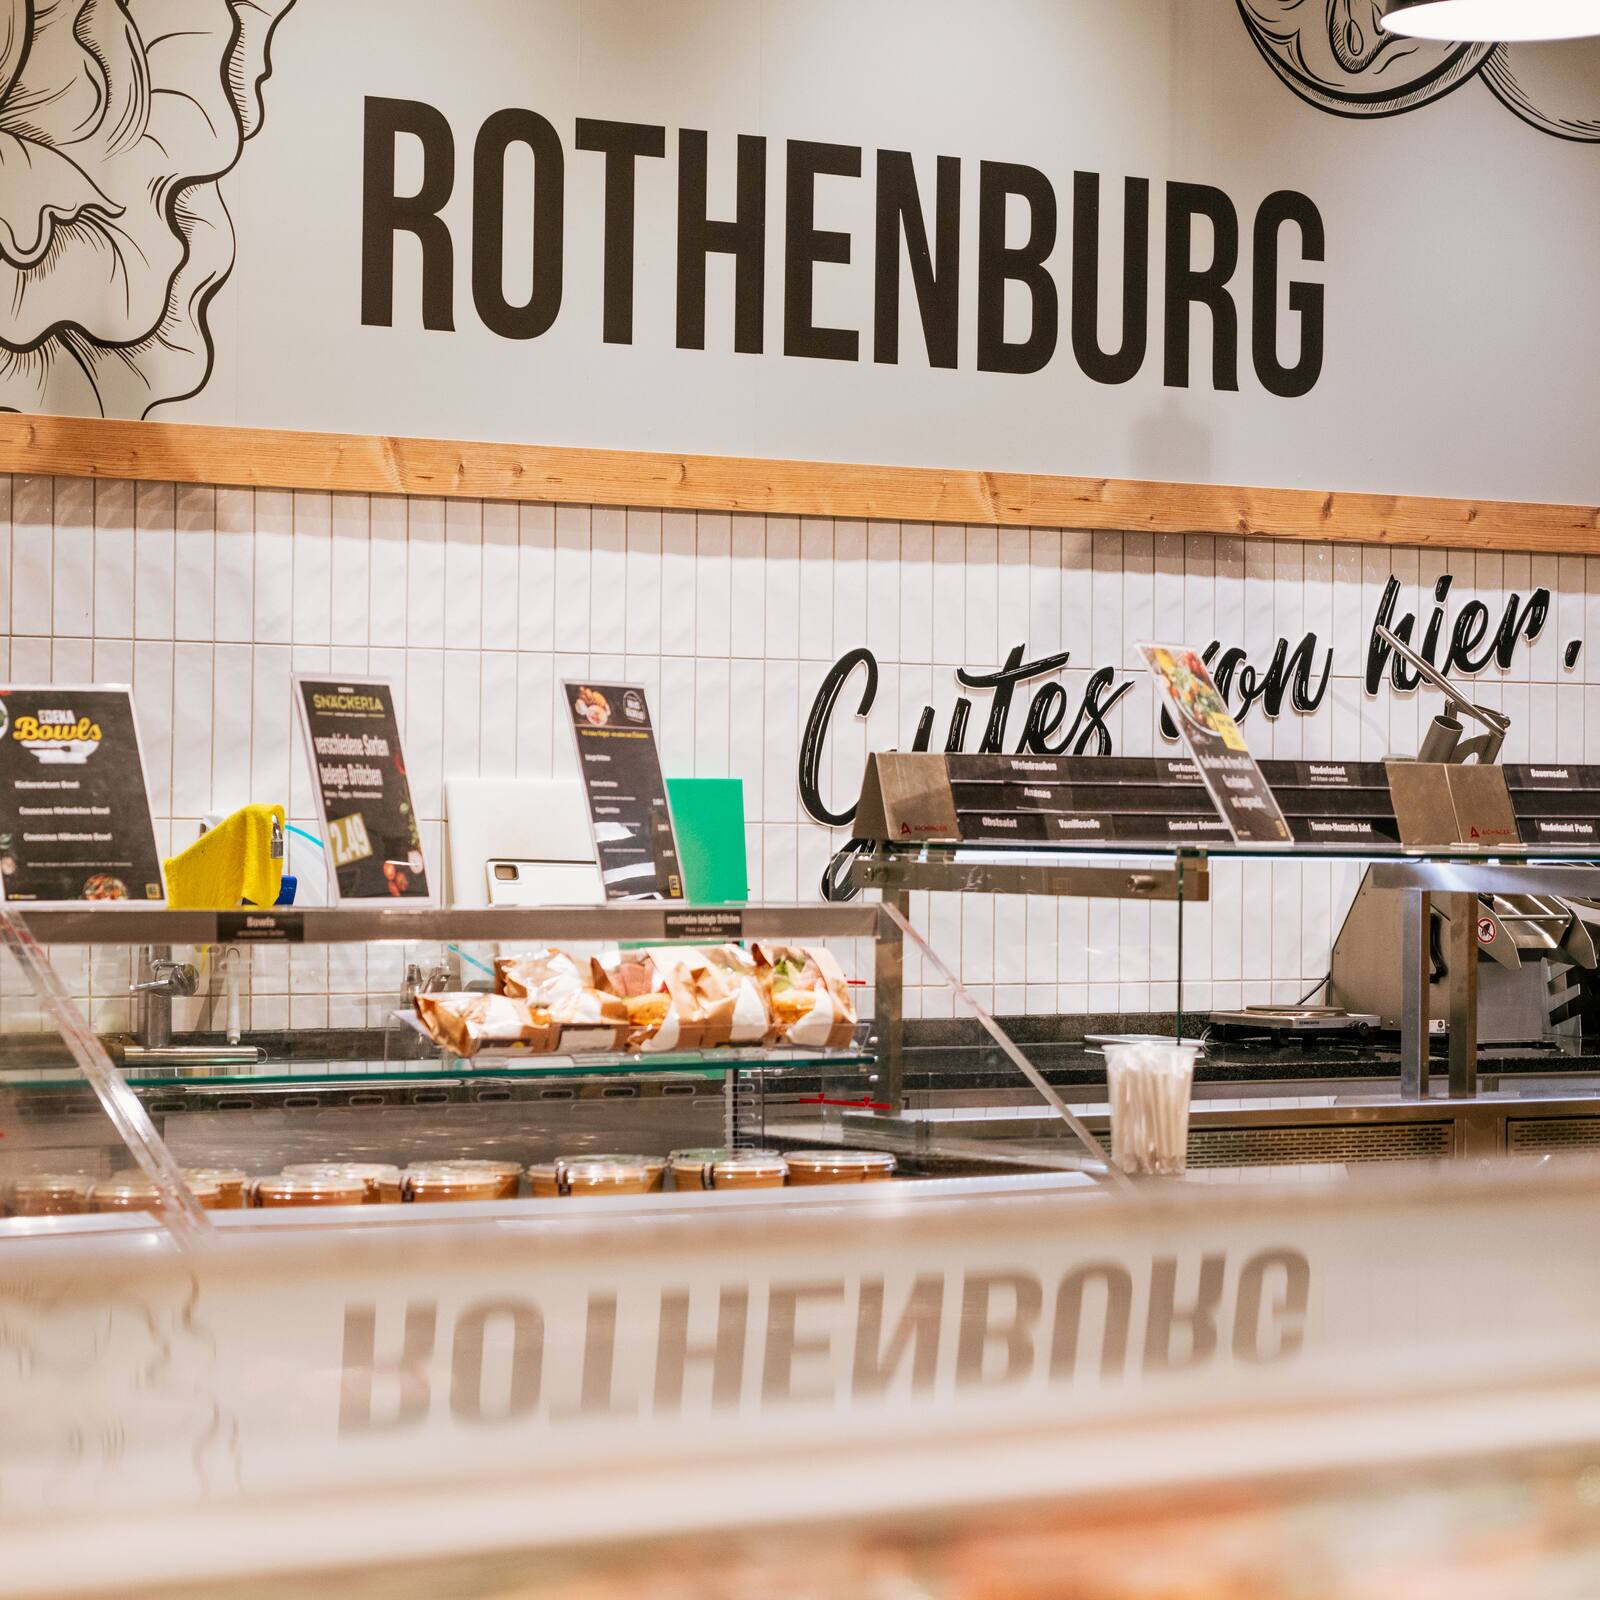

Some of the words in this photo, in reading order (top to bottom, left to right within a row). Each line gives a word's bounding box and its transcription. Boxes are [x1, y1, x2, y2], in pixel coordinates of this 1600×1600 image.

[361, 96, 1326, 398] ROTHENBURG
[12, 716, 102, 741] Bowls
[1010, 760, 1058, 772] Weintrauben
[1309, 765, 1346, 776] Nudelsalat
[1530, 768, 1568, 778] Bauernsalat
[1023, 787, 1052, 800] Ananas
[981, 816, 1018, 829] Obstsalat
[1057, 818, 1101, 830] Vanillesoße
[1358, 823, 1372, 832] Salat
[1540, 822, 1574, 833] Nudelsalat
